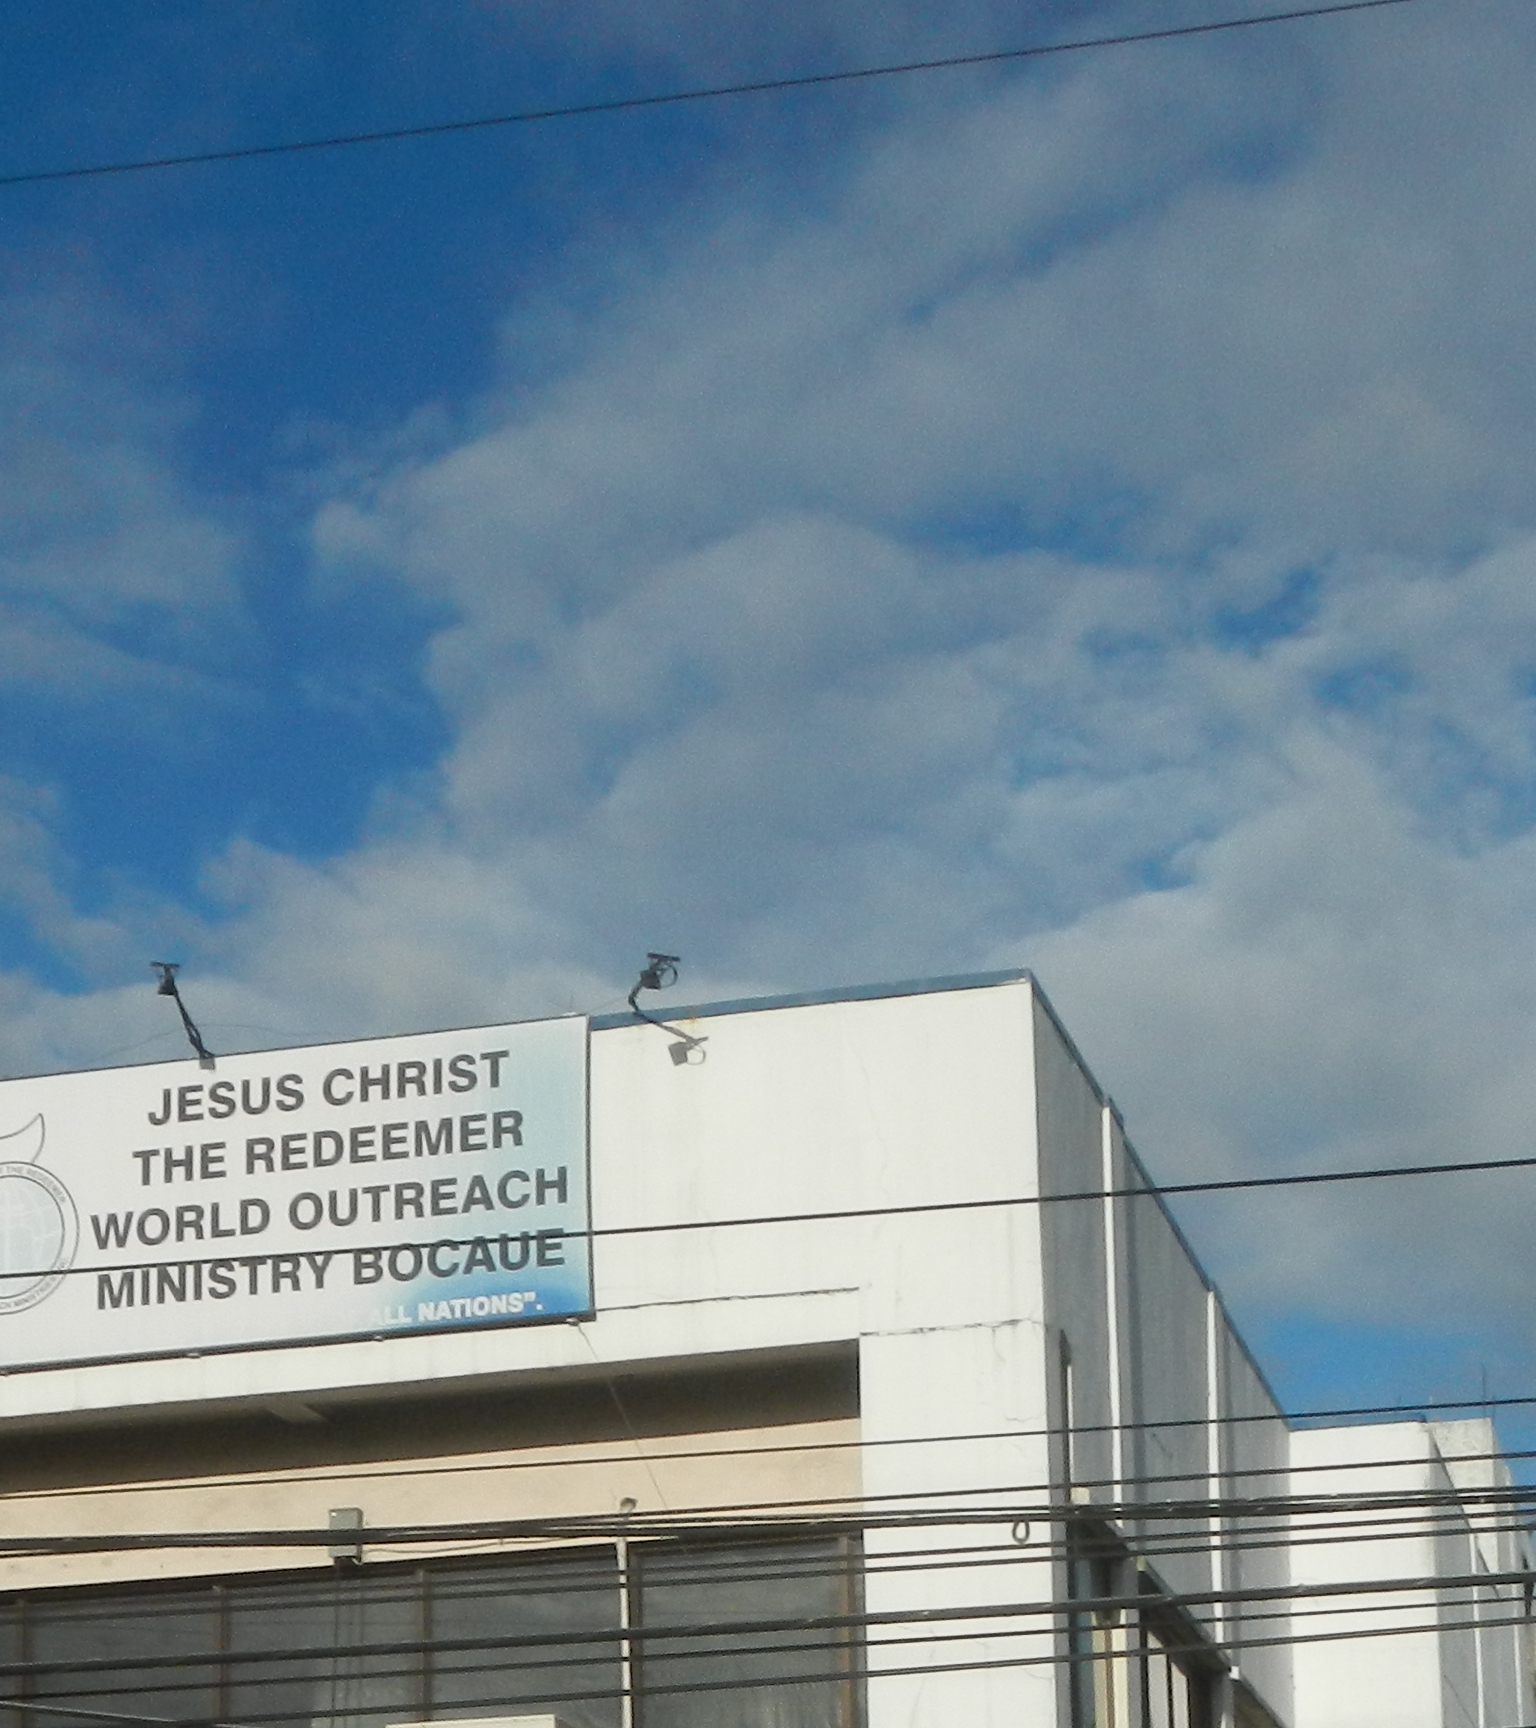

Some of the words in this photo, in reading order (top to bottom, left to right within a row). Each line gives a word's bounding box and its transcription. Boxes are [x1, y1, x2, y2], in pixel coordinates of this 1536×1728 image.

[148, 1072, 305, 1126] JESUS
[322, 1049, 510, 1107] CHRIST
[132, 1142, 228, 1187] THE
[245, 1109, 525, 1176] REDEEMER
[90, 1197, 271, 1251] WORLD
[288, 1165, 569, 1231] OUTREACH
[96, 1251, 333, 1310] MINISTRY
[352, 1227, 566, 1286] BOCAUE
